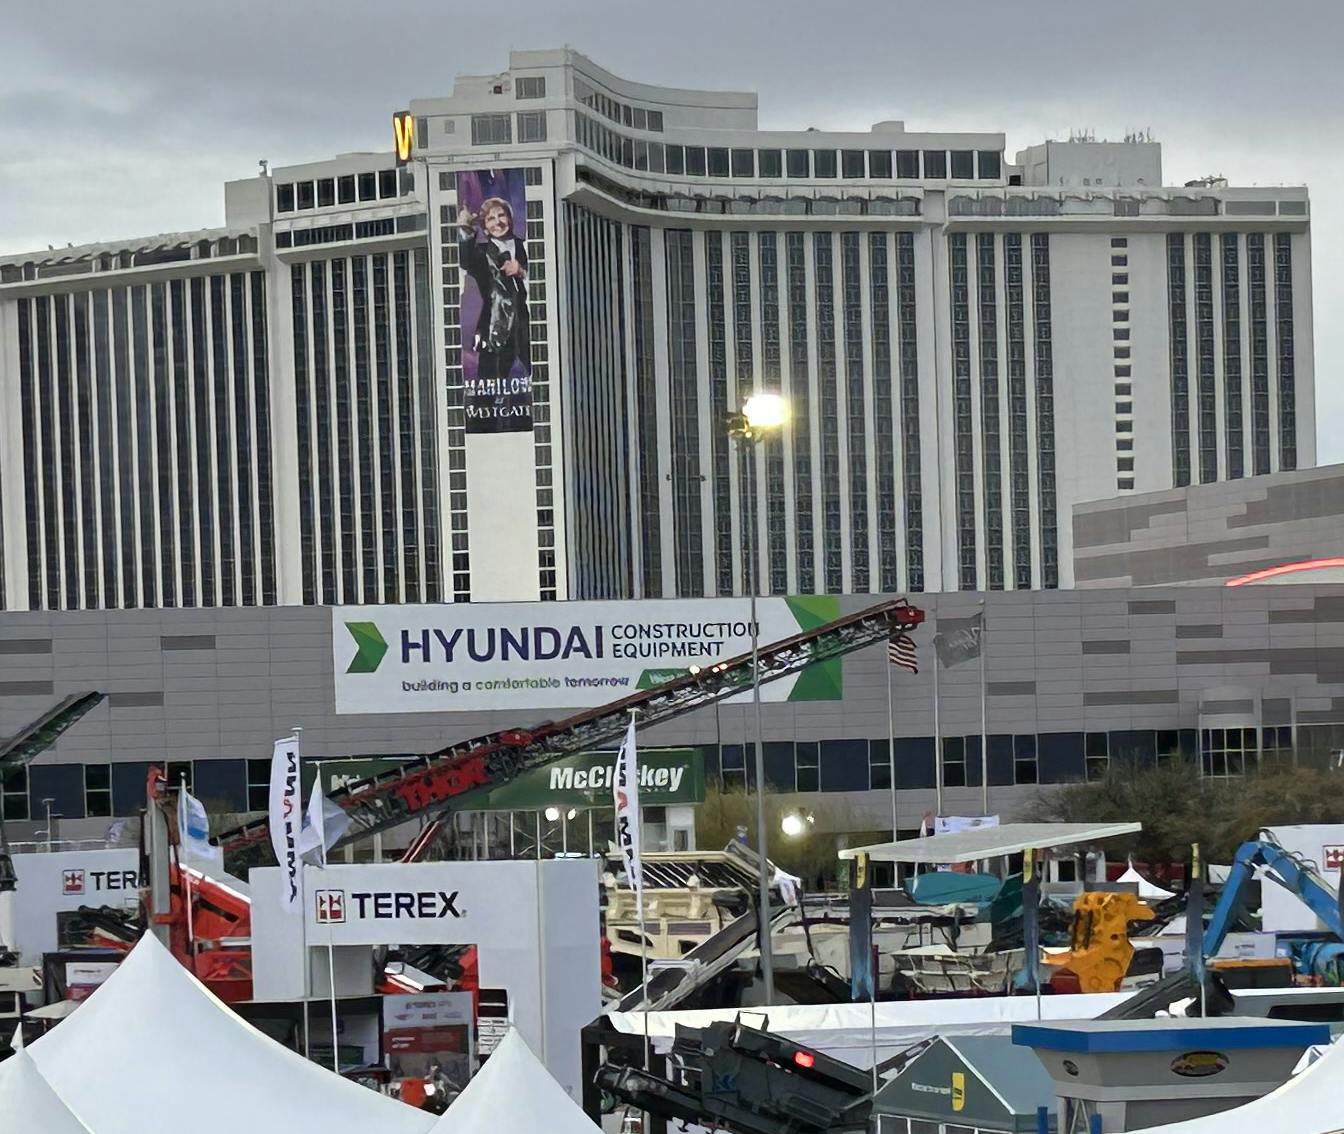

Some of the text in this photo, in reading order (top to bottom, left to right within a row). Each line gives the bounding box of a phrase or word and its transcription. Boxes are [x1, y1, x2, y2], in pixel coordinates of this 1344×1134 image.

[401, 621, 760, 663] HYUNDAI CONSTRUCTION
[613, 640, 724, 659] EQUIPMENT
[402, 674, 630, 694] building a comfortable tomorrow
[550, 764, 685, 792] McClkey
[352, 892, 459, 919] TEREX
